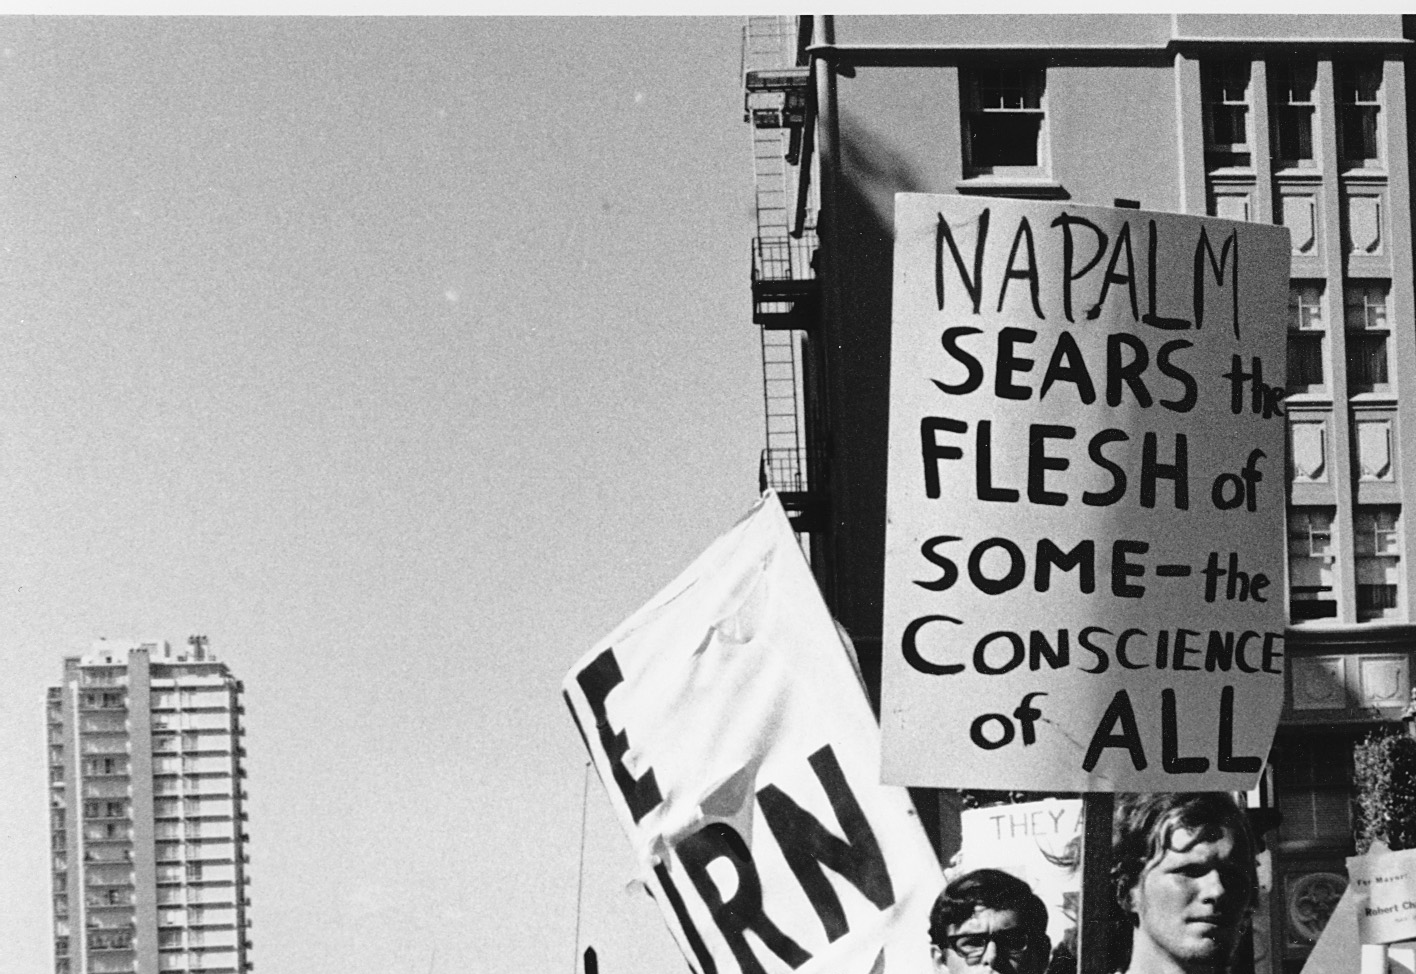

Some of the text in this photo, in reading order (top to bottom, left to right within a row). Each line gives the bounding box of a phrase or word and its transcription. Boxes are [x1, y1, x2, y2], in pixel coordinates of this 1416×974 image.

[936, 208, 1241, 340] NAPALM
[930, 327, 1285, 419] SEARS the
[920, 416, 1268, 512] FLESH of
[969, 686, 1263, 774] of ALL
[990, 809, 1065, 840] THEY
[1365, 904, 1399, 916] Robert
